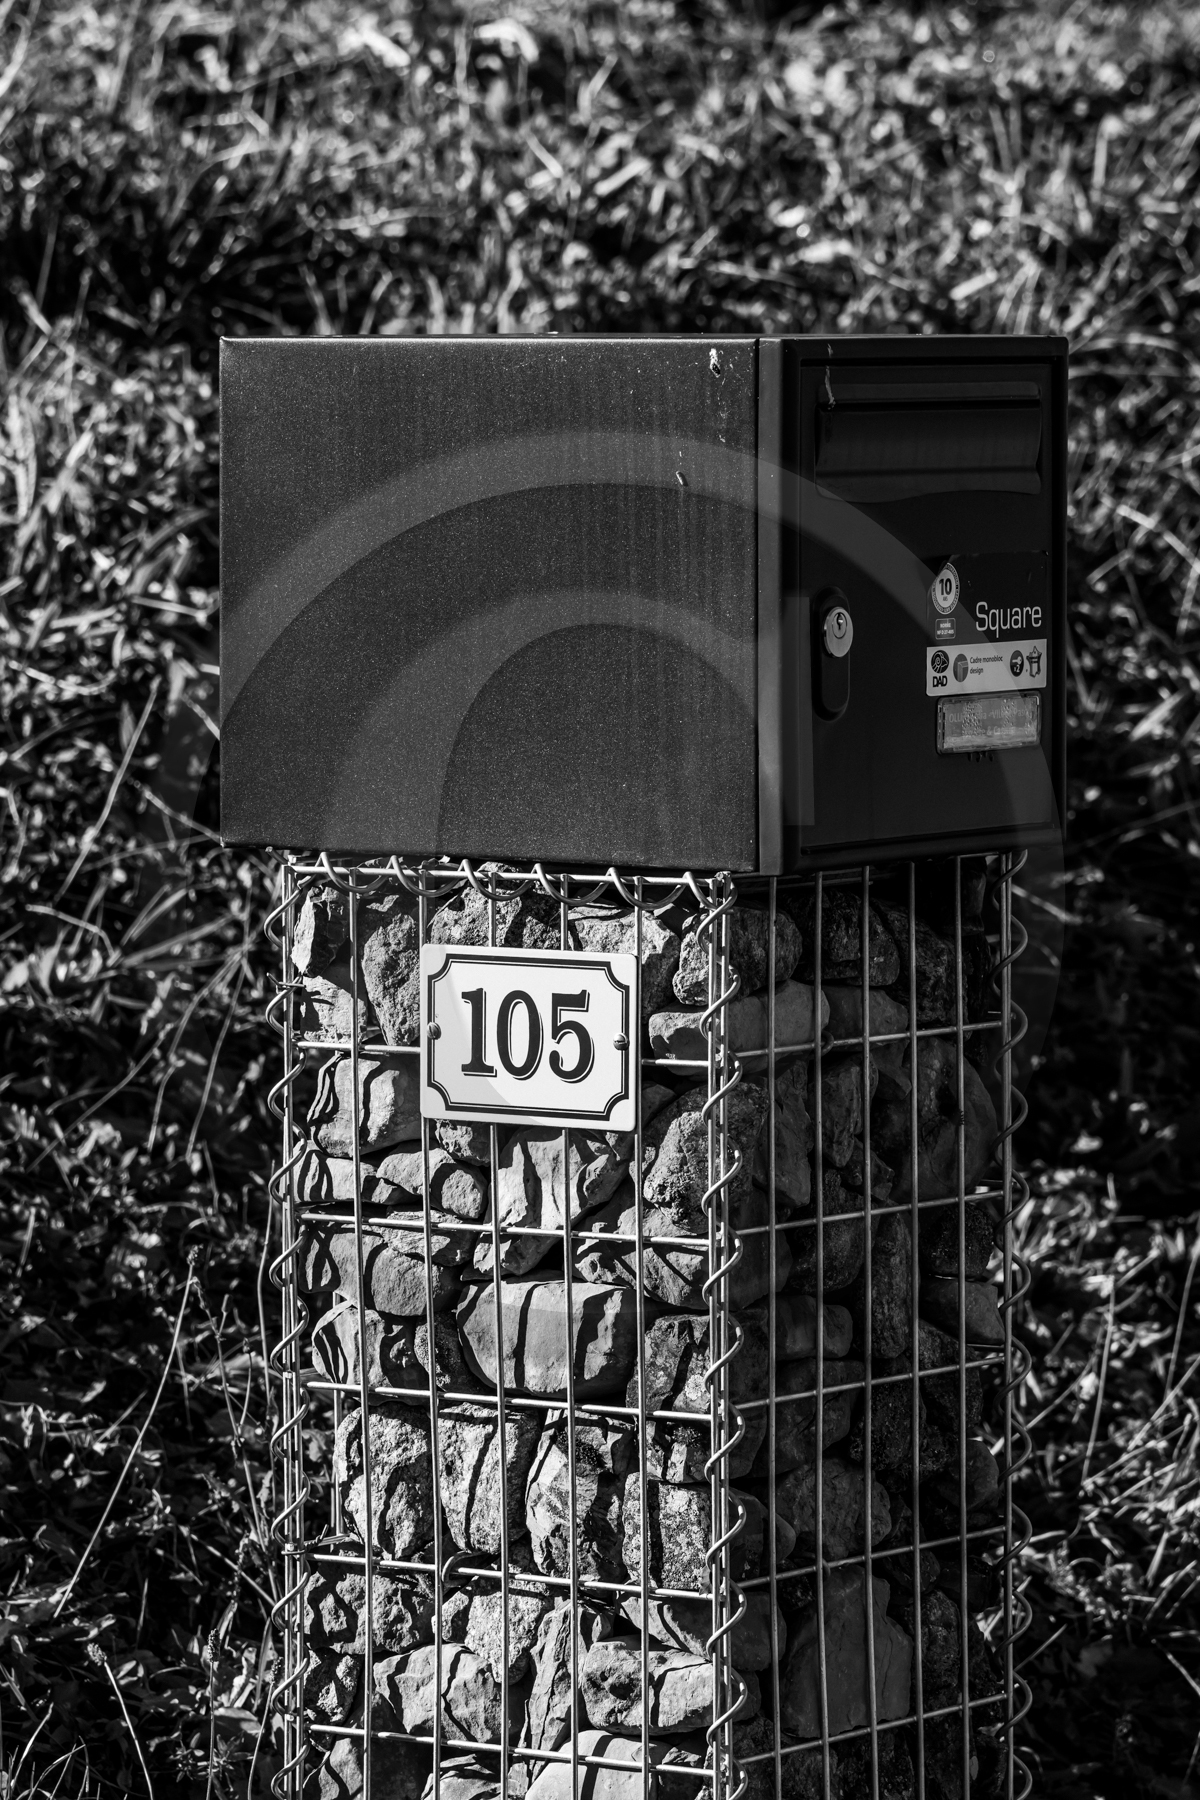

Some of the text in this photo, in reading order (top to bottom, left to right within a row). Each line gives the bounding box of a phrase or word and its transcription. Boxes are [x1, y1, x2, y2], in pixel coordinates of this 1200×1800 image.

[938, 577, 953, 596] 10
[975, 601, 1042, 638] Square
[969, 655, 1003, 664] Cadre monobloc
[969, 667, 984, 676] design
[932, 675, 948, 688] DAD
[461, 987, 595, 1084] 105
